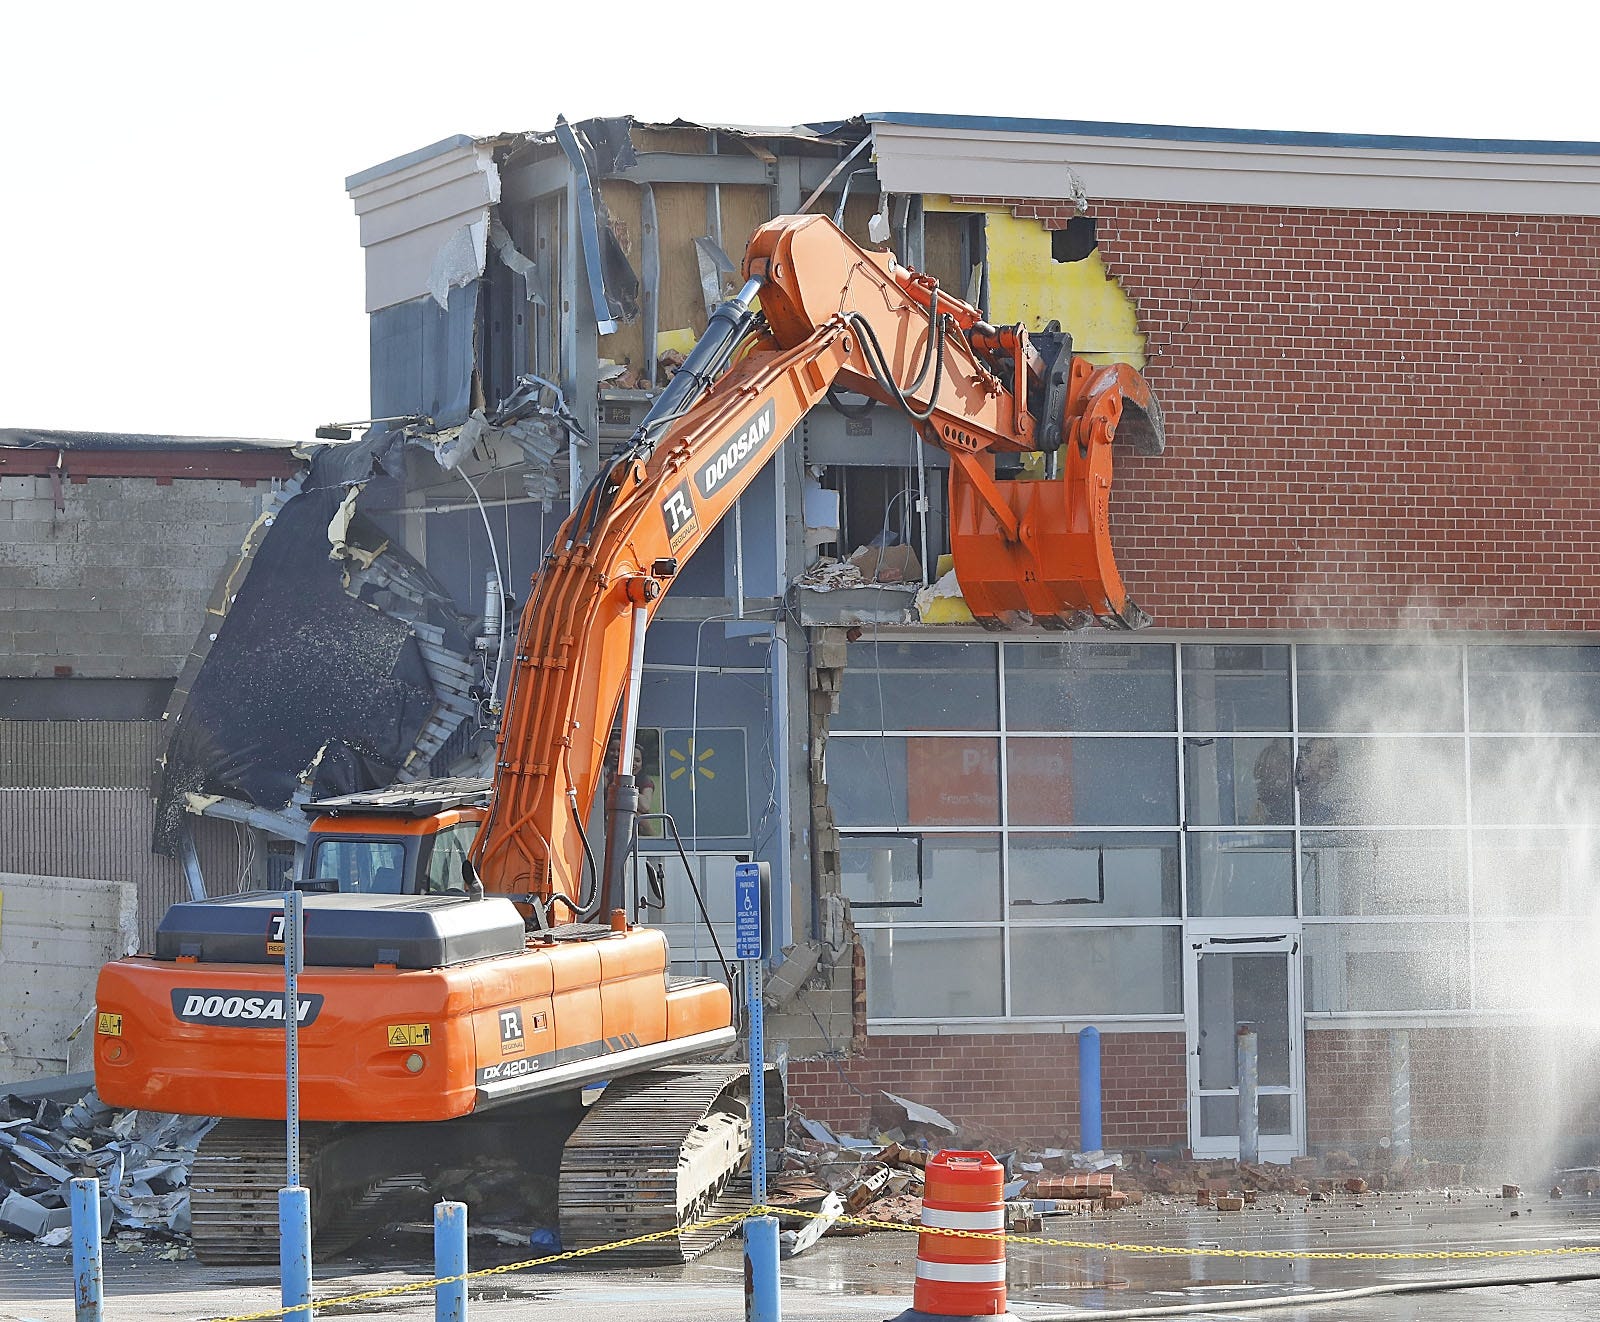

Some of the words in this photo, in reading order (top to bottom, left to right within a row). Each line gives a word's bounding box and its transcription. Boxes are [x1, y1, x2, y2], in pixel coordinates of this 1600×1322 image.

[705, 410, 770, 493] DOOSAN
[671, 523, 697, 550] REGIONAL
[502, 1042, 523, 1051] REGIONAL
